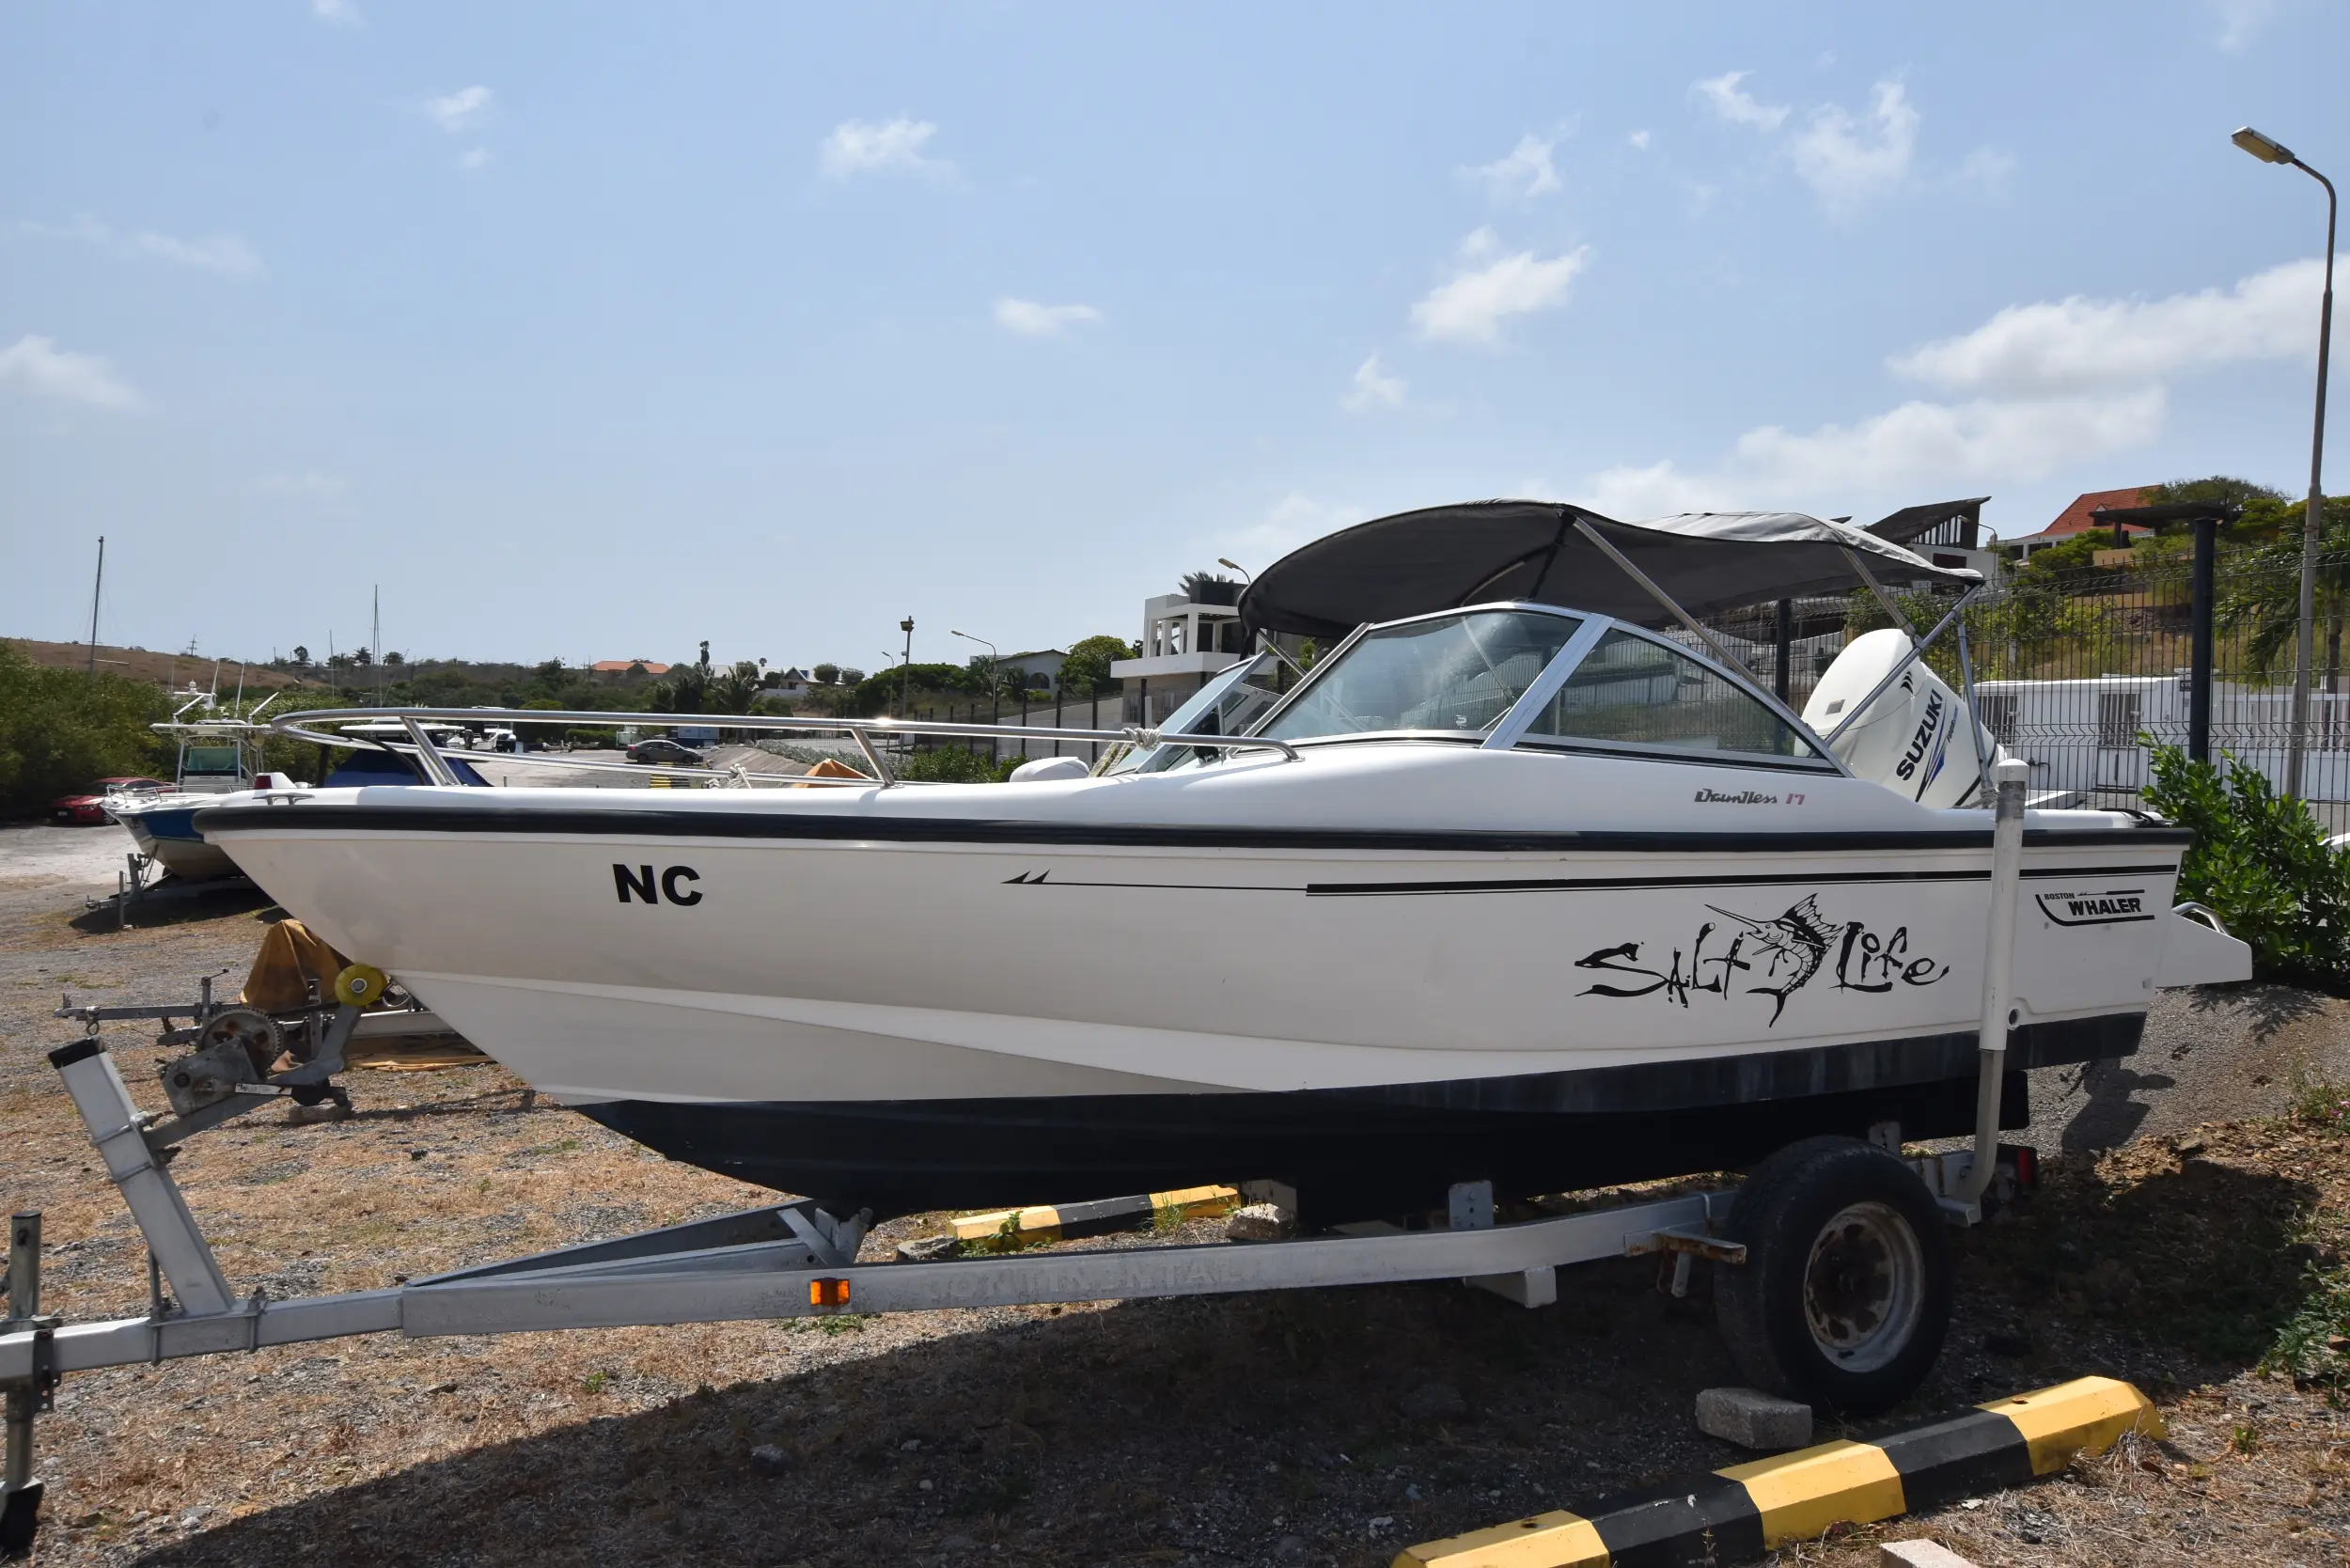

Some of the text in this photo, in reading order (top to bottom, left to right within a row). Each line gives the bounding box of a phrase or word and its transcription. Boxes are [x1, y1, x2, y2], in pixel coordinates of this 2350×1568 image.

[1896, 688, 1943, 781] SUZUKI
[1695, 788, 1805, 805] Dauntless 17
[612, 863, 703, 906] NC
[2044, 892, 2076, 901] BOSTON
[2068, 897, 2142, 917] WHALER
